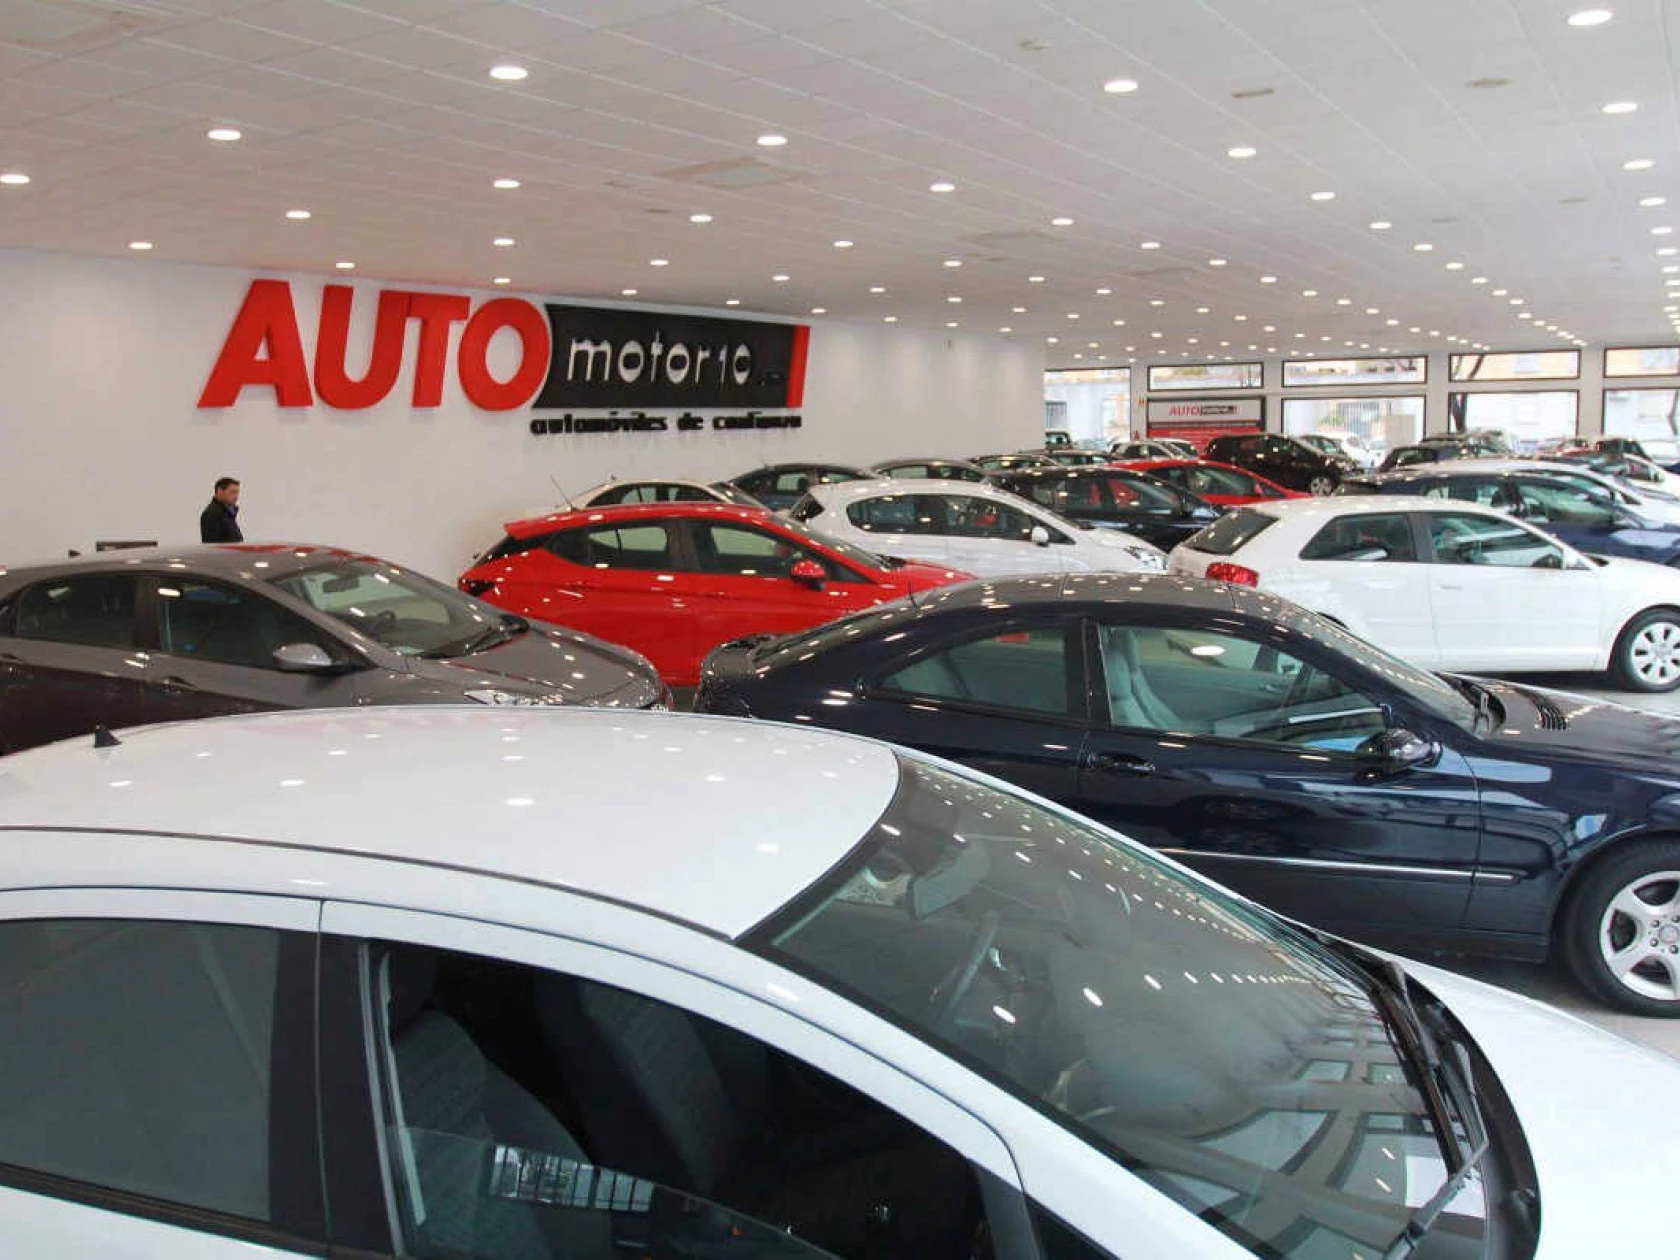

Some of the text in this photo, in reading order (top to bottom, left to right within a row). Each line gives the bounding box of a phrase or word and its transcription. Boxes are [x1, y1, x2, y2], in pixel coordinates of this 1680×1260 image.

[197, 278, 551, 412] AUTO
[1168, 404, 1201, 417] AUTO
[677, 413, 703, 431] de
